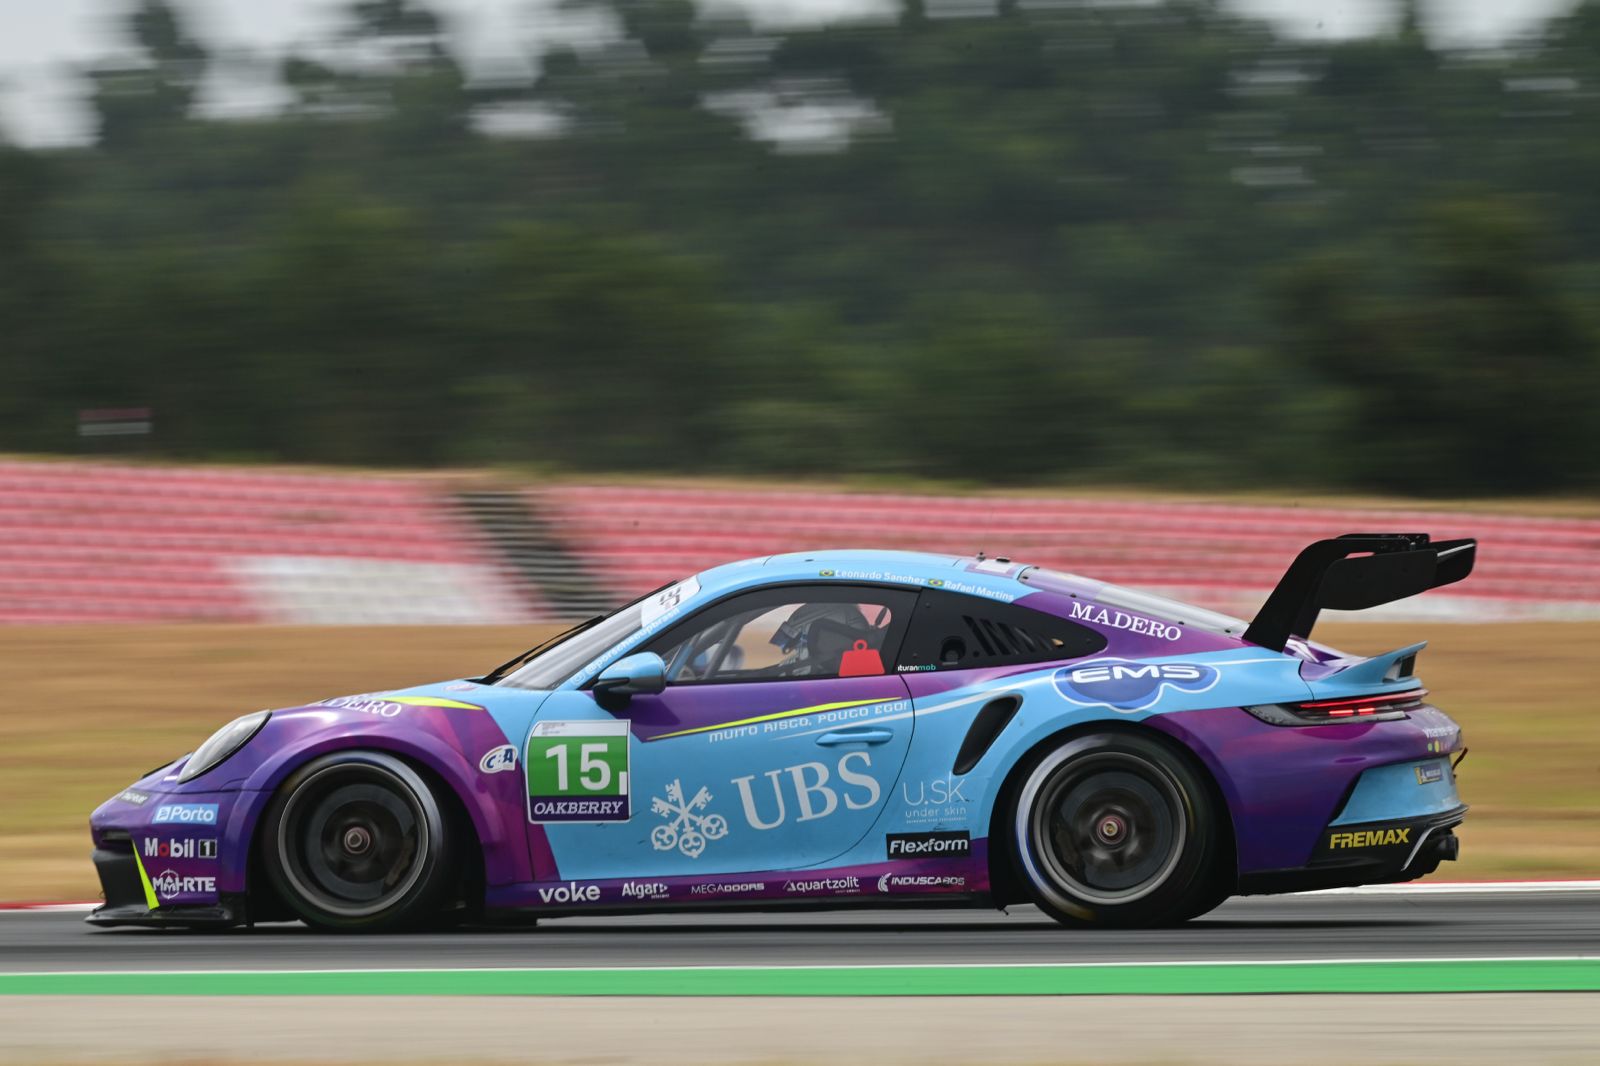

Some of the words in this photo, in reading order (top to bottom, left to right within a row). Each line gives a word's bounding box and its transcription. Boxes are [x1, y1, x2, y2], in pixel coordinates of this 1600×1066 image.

[835, 569, 882, 580] Leonardo
[884, 572, 926, 584] Sanchez
[944, 580, 975, 593] Rafael
[976, 586, 1014, 601] Martins
[1069, 601, 1182, 641] MADERO
[1072, 665, 1200, 684] EMS
[709, 726, 758, 743] MUITO
[763, 717, 812, 733] RISCO,
[818, 708, 869, 724] POUCO
[874, 701, 907, 714] EGO!
[545, 743, 611, 791] 15
[730, 751, 881, 830] UBS
[169, 806, 214, 822] Porto
[533, 801, 623, 815] OAKBERRY
[905, 808, 939, 818] under
[944, 806, 967, 816] skin
[144, 837, 194, 858] Mobil
[889, 839, 969, 854] Flexform
[1329, 828, 1410, 849] FREMAX
[538, 881, 601, 903] voke
[621, 881, 659, 899] Algar
[690, 883, 765, 895] MEGADOORS
[796, 876, 860, 893] quartzolit
